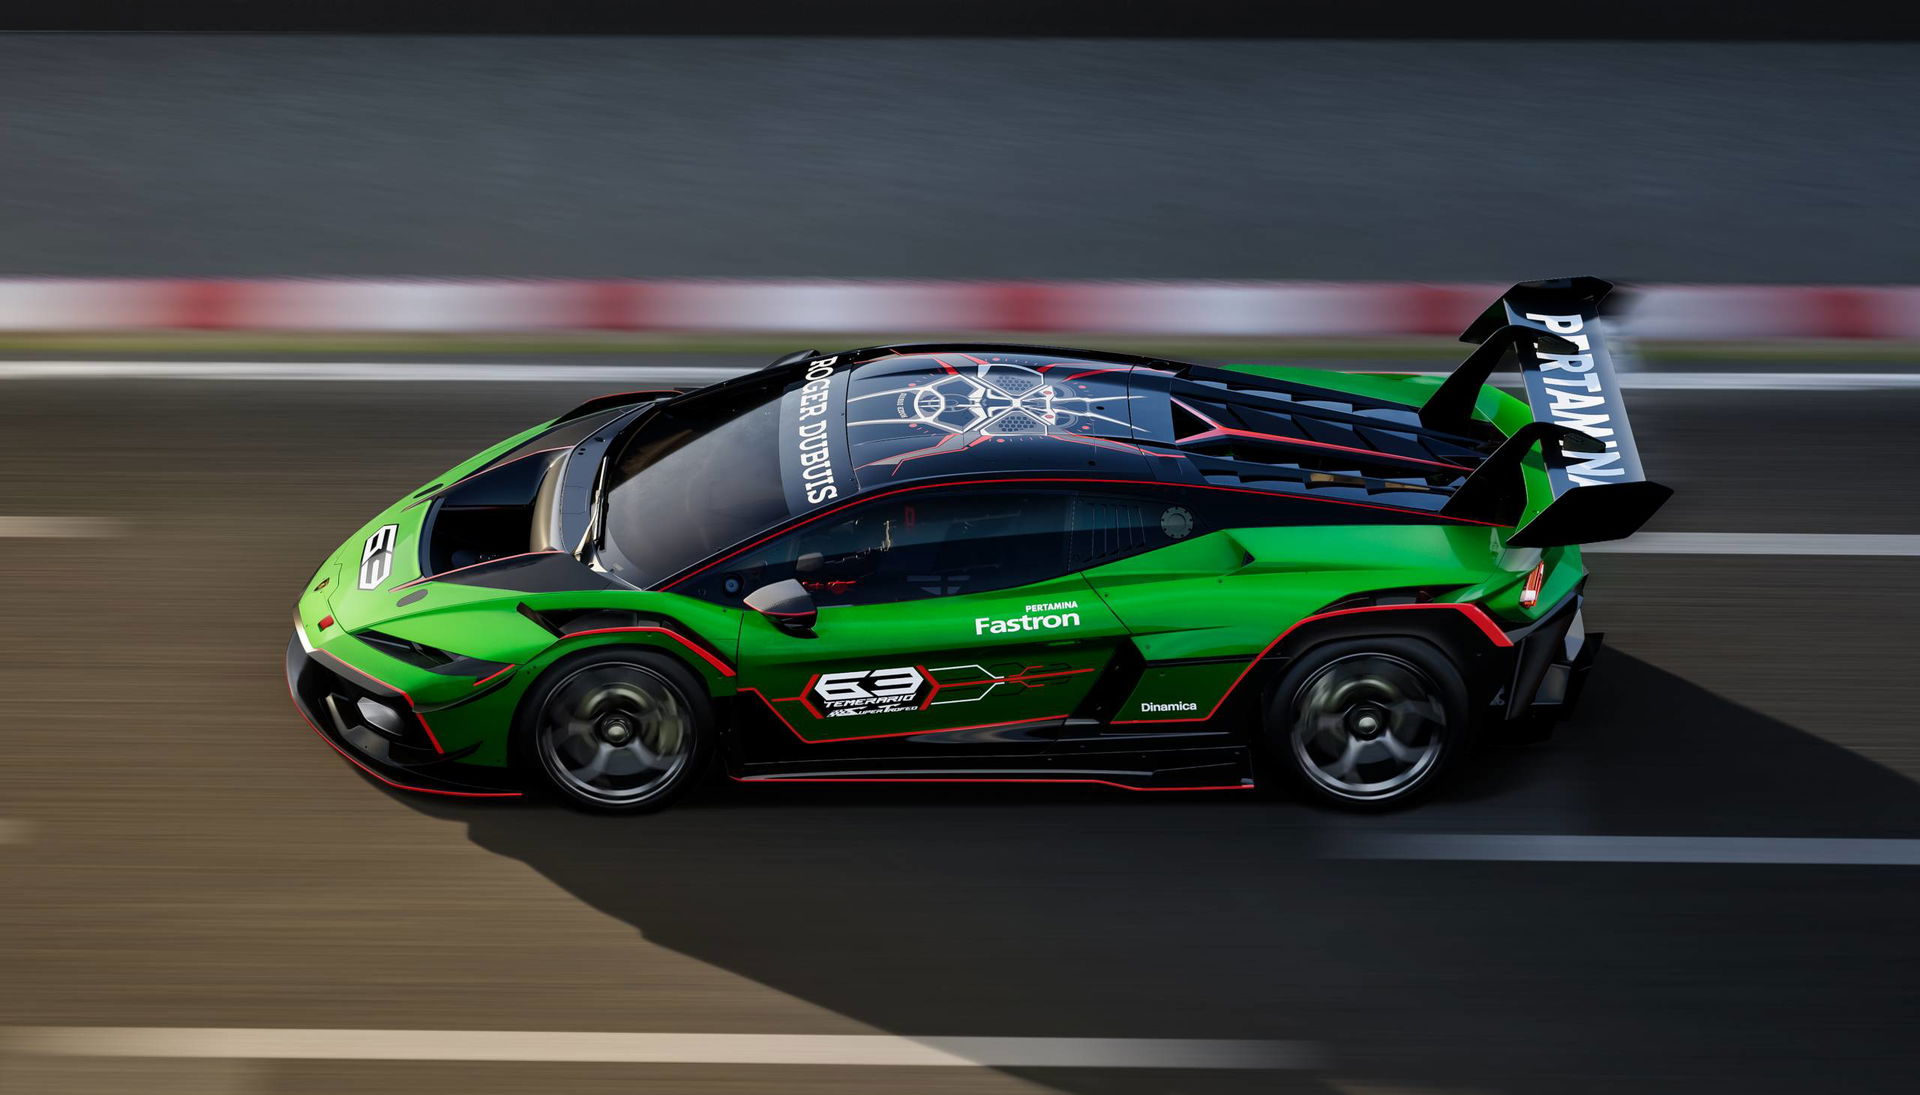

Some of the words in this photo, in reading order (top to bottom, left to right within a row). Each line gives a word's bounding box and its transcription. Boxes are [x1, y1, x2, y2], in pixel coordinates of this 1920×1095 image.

[799, 356, 838, 421] ROGER
[799, 420, 838, 504] DUBUIS
[359, 524, 398, 590] 63
[1025, 600, 1078, 612] PERTAMINA
[975, 612, 1080, 635] Fastron
[814, 666, 924, 701] 63
[824, 693, 917, 708] TEMERARIO
[1141, 701, 1197, 712] Dinamica
